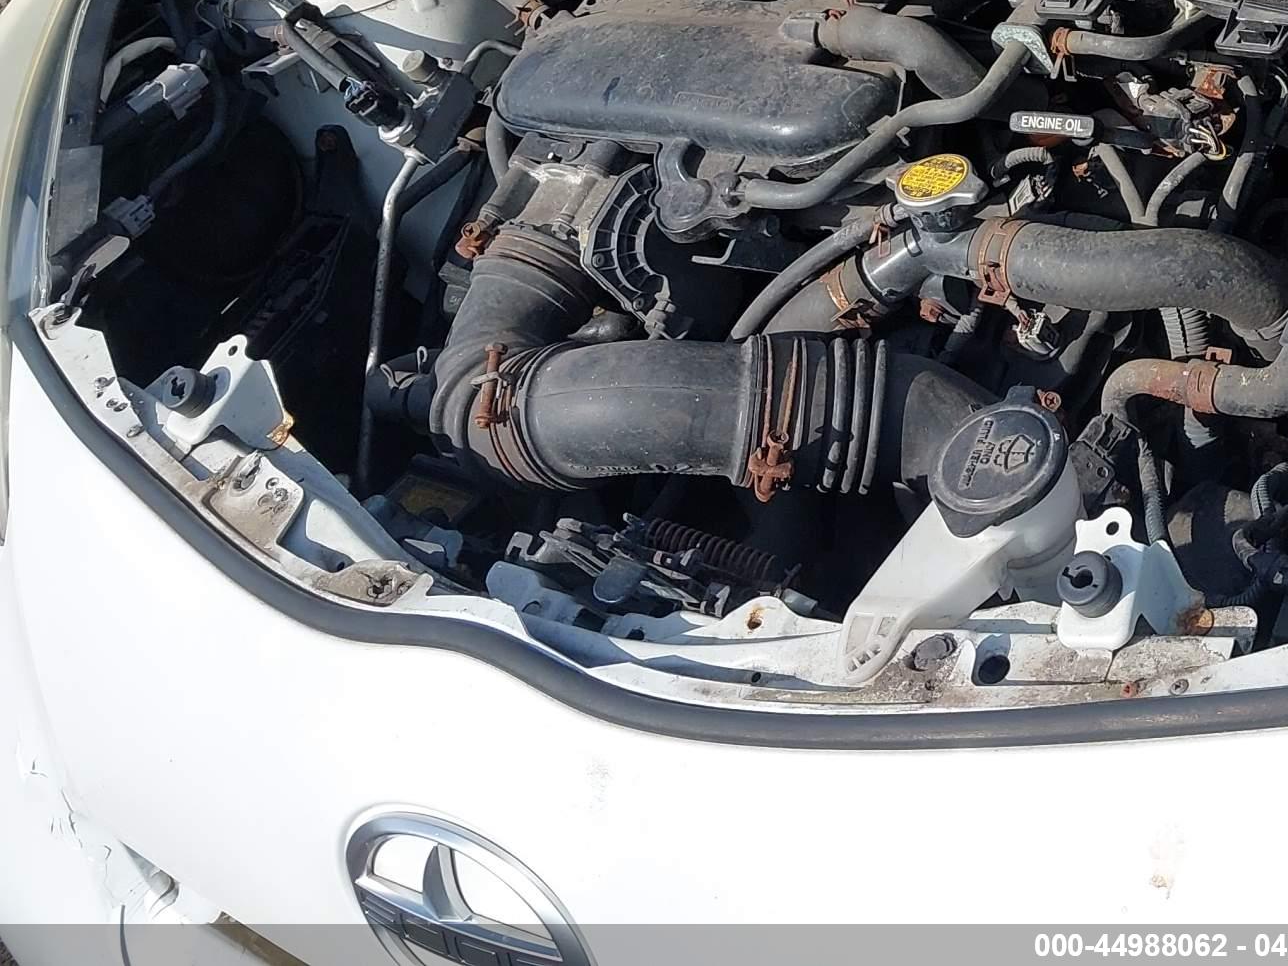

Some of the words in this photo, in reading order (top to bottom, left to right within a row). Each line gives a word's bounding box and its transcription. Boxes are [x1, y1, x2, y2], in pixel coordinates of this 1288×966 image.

[1021, 115, 1063, 130] ENGINE
[1065, 118, 1084, 132] OIL
[980, 441, 996, 465] ONLY
